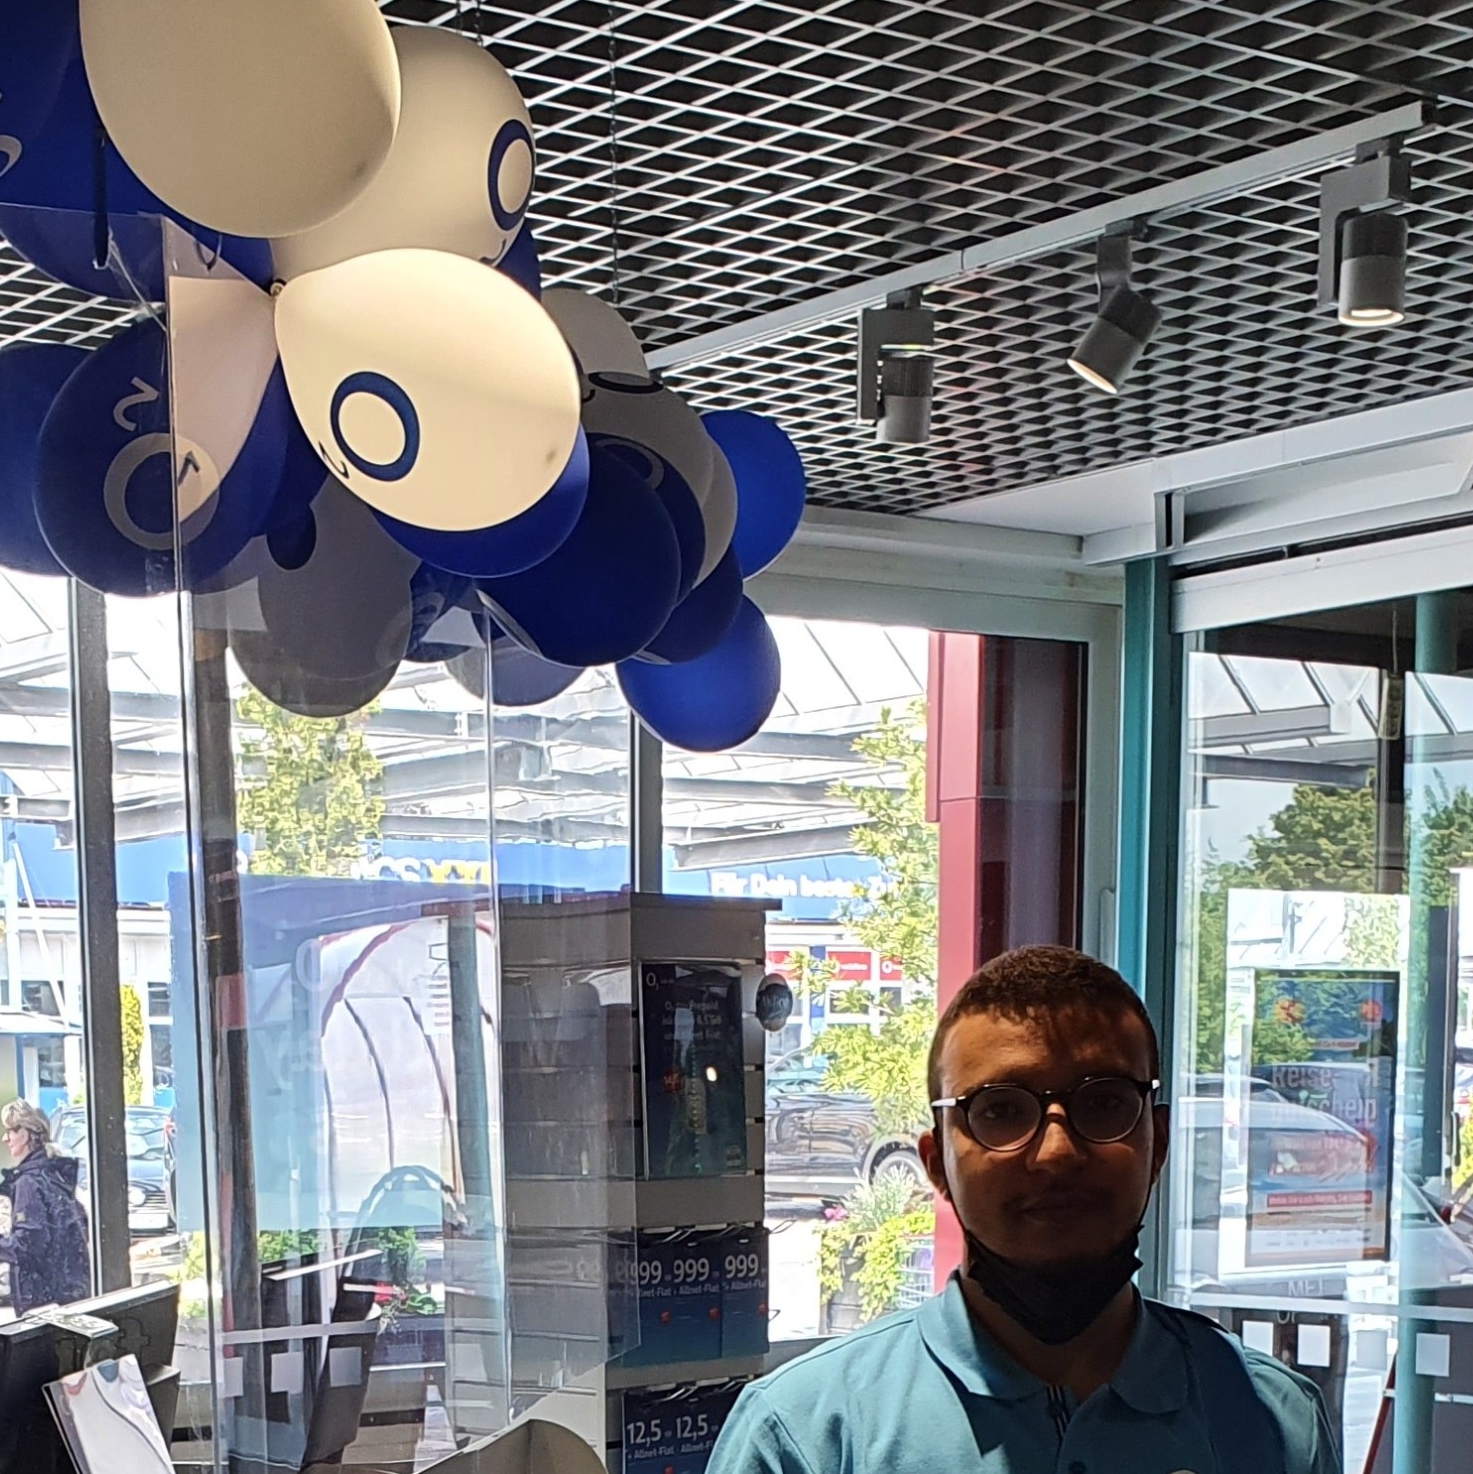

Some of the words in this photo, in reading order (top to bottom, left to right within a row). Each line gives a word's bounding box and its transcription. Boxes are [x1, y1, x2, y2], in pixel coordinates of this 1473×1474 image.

[673, 1257, 710, 1283] 999
[725, 1253, 759, 1279] 999
[626, 1418, 662, 1448] 12,5
[676, 1414, 709, 1441] 12,5
